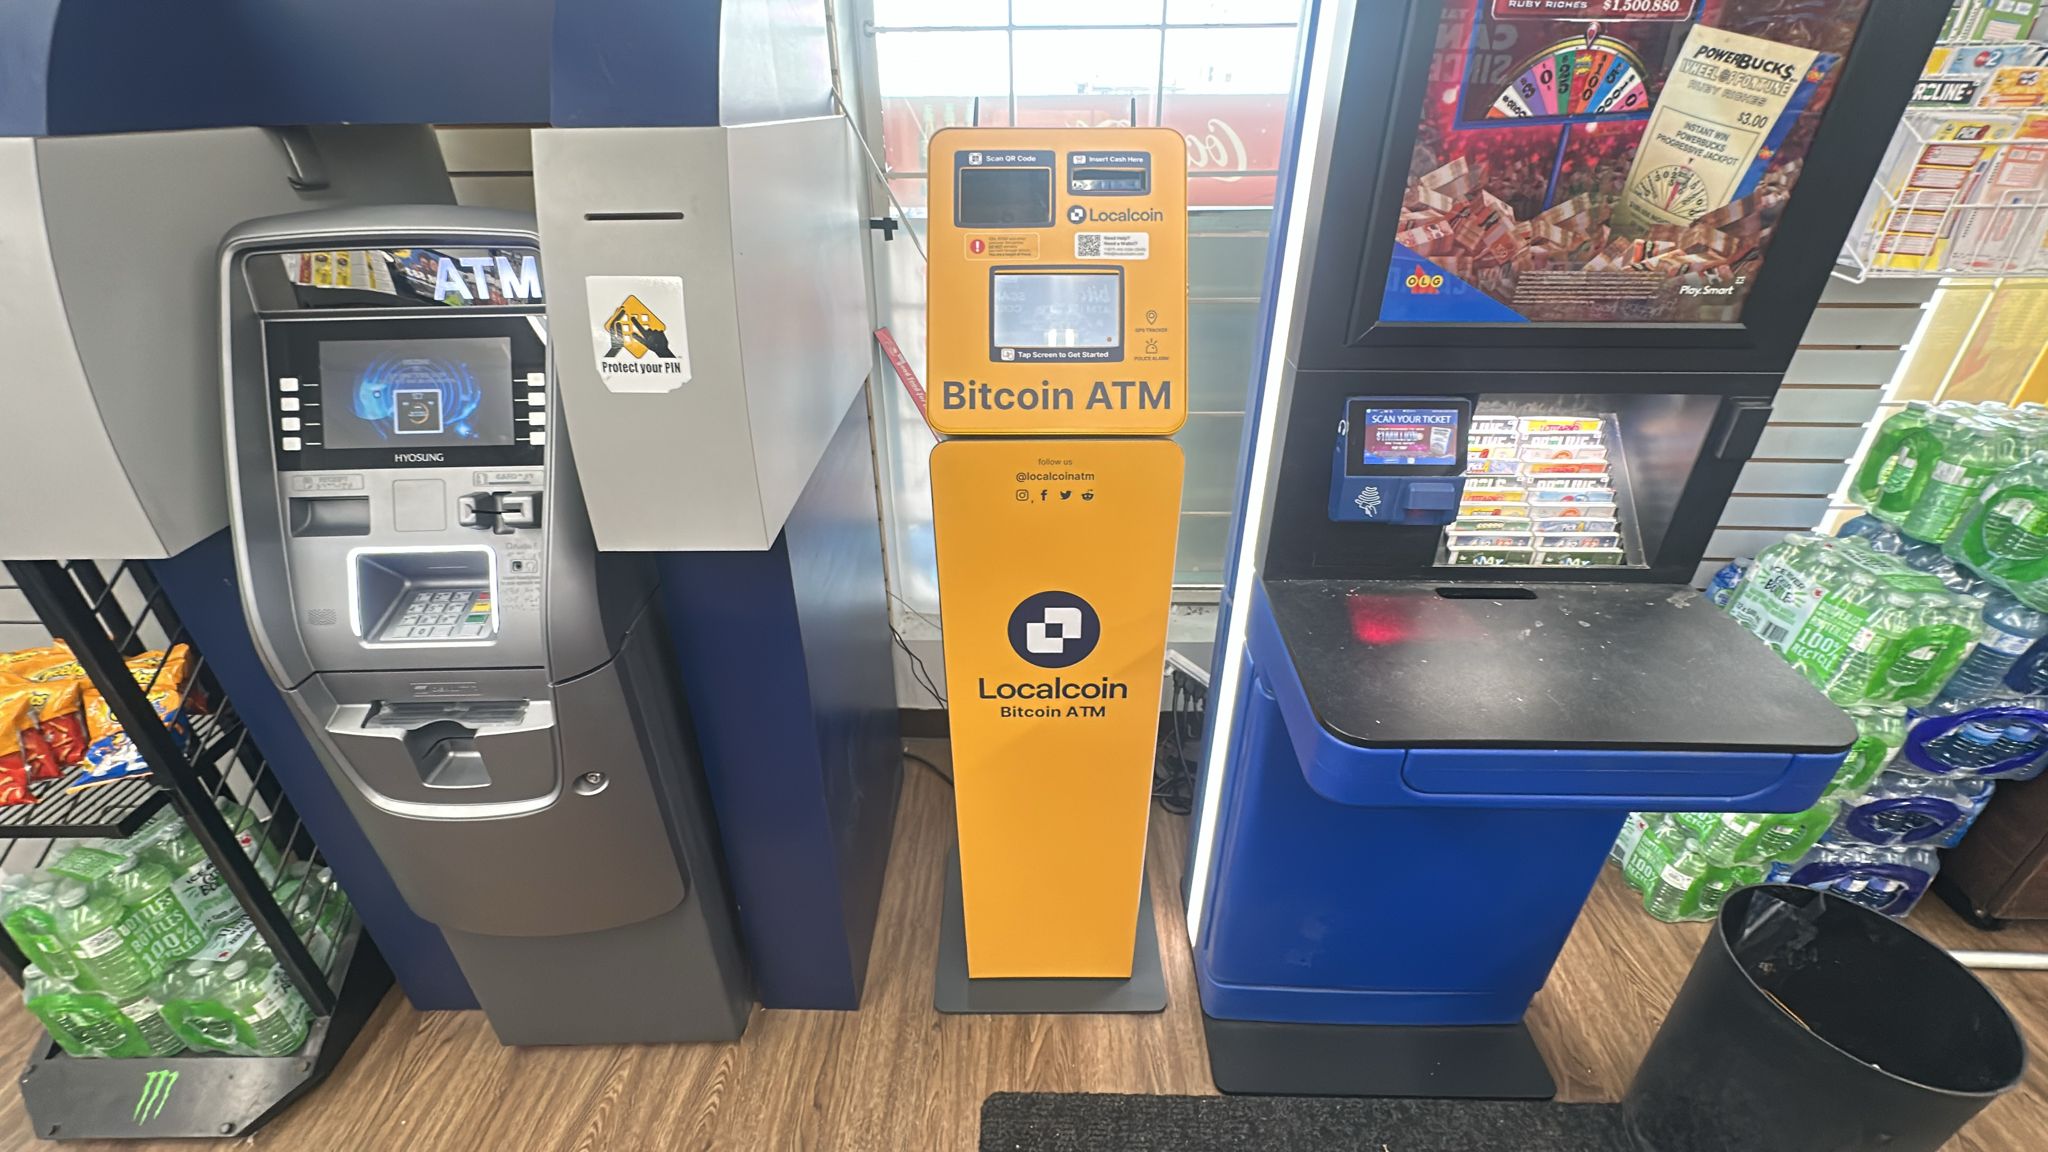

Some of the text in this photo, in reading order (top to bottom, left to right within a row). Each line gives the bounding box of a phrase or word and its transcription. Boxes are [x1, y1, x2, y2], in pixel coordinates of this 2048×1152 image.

[1508, 0, 1588, 9] RUBY RICHES
[1737, 112, 1768, 128] $3.00
[1684, 122, 1717, 138] INSTANT
[1656, 133, 1739, 167] PROGRESSIVE JACKPOT
[1090, 208, 1164, 222] Localcoin
[434, 256, 543, 300] ATM
[1406, 274, 1444, 288] OLG
[602, 362, 681, 374] Protect your PIN
[943, 380, 1170, 410] Bitcoin ATM
[1372, 416, 1452, 424] SCAN YOUR TICKET
[394, 454, 444, 462] HYOSUNG
[1016, 472, 1095, 482] @localcoinatm
[979, 677, 1128, 699] Localcoin
[1000, 706, 1106, 718] Bitcoin ATM
[130, 910, 184, 952] BOTTLES
[142, 921, 196, 968] 100%
